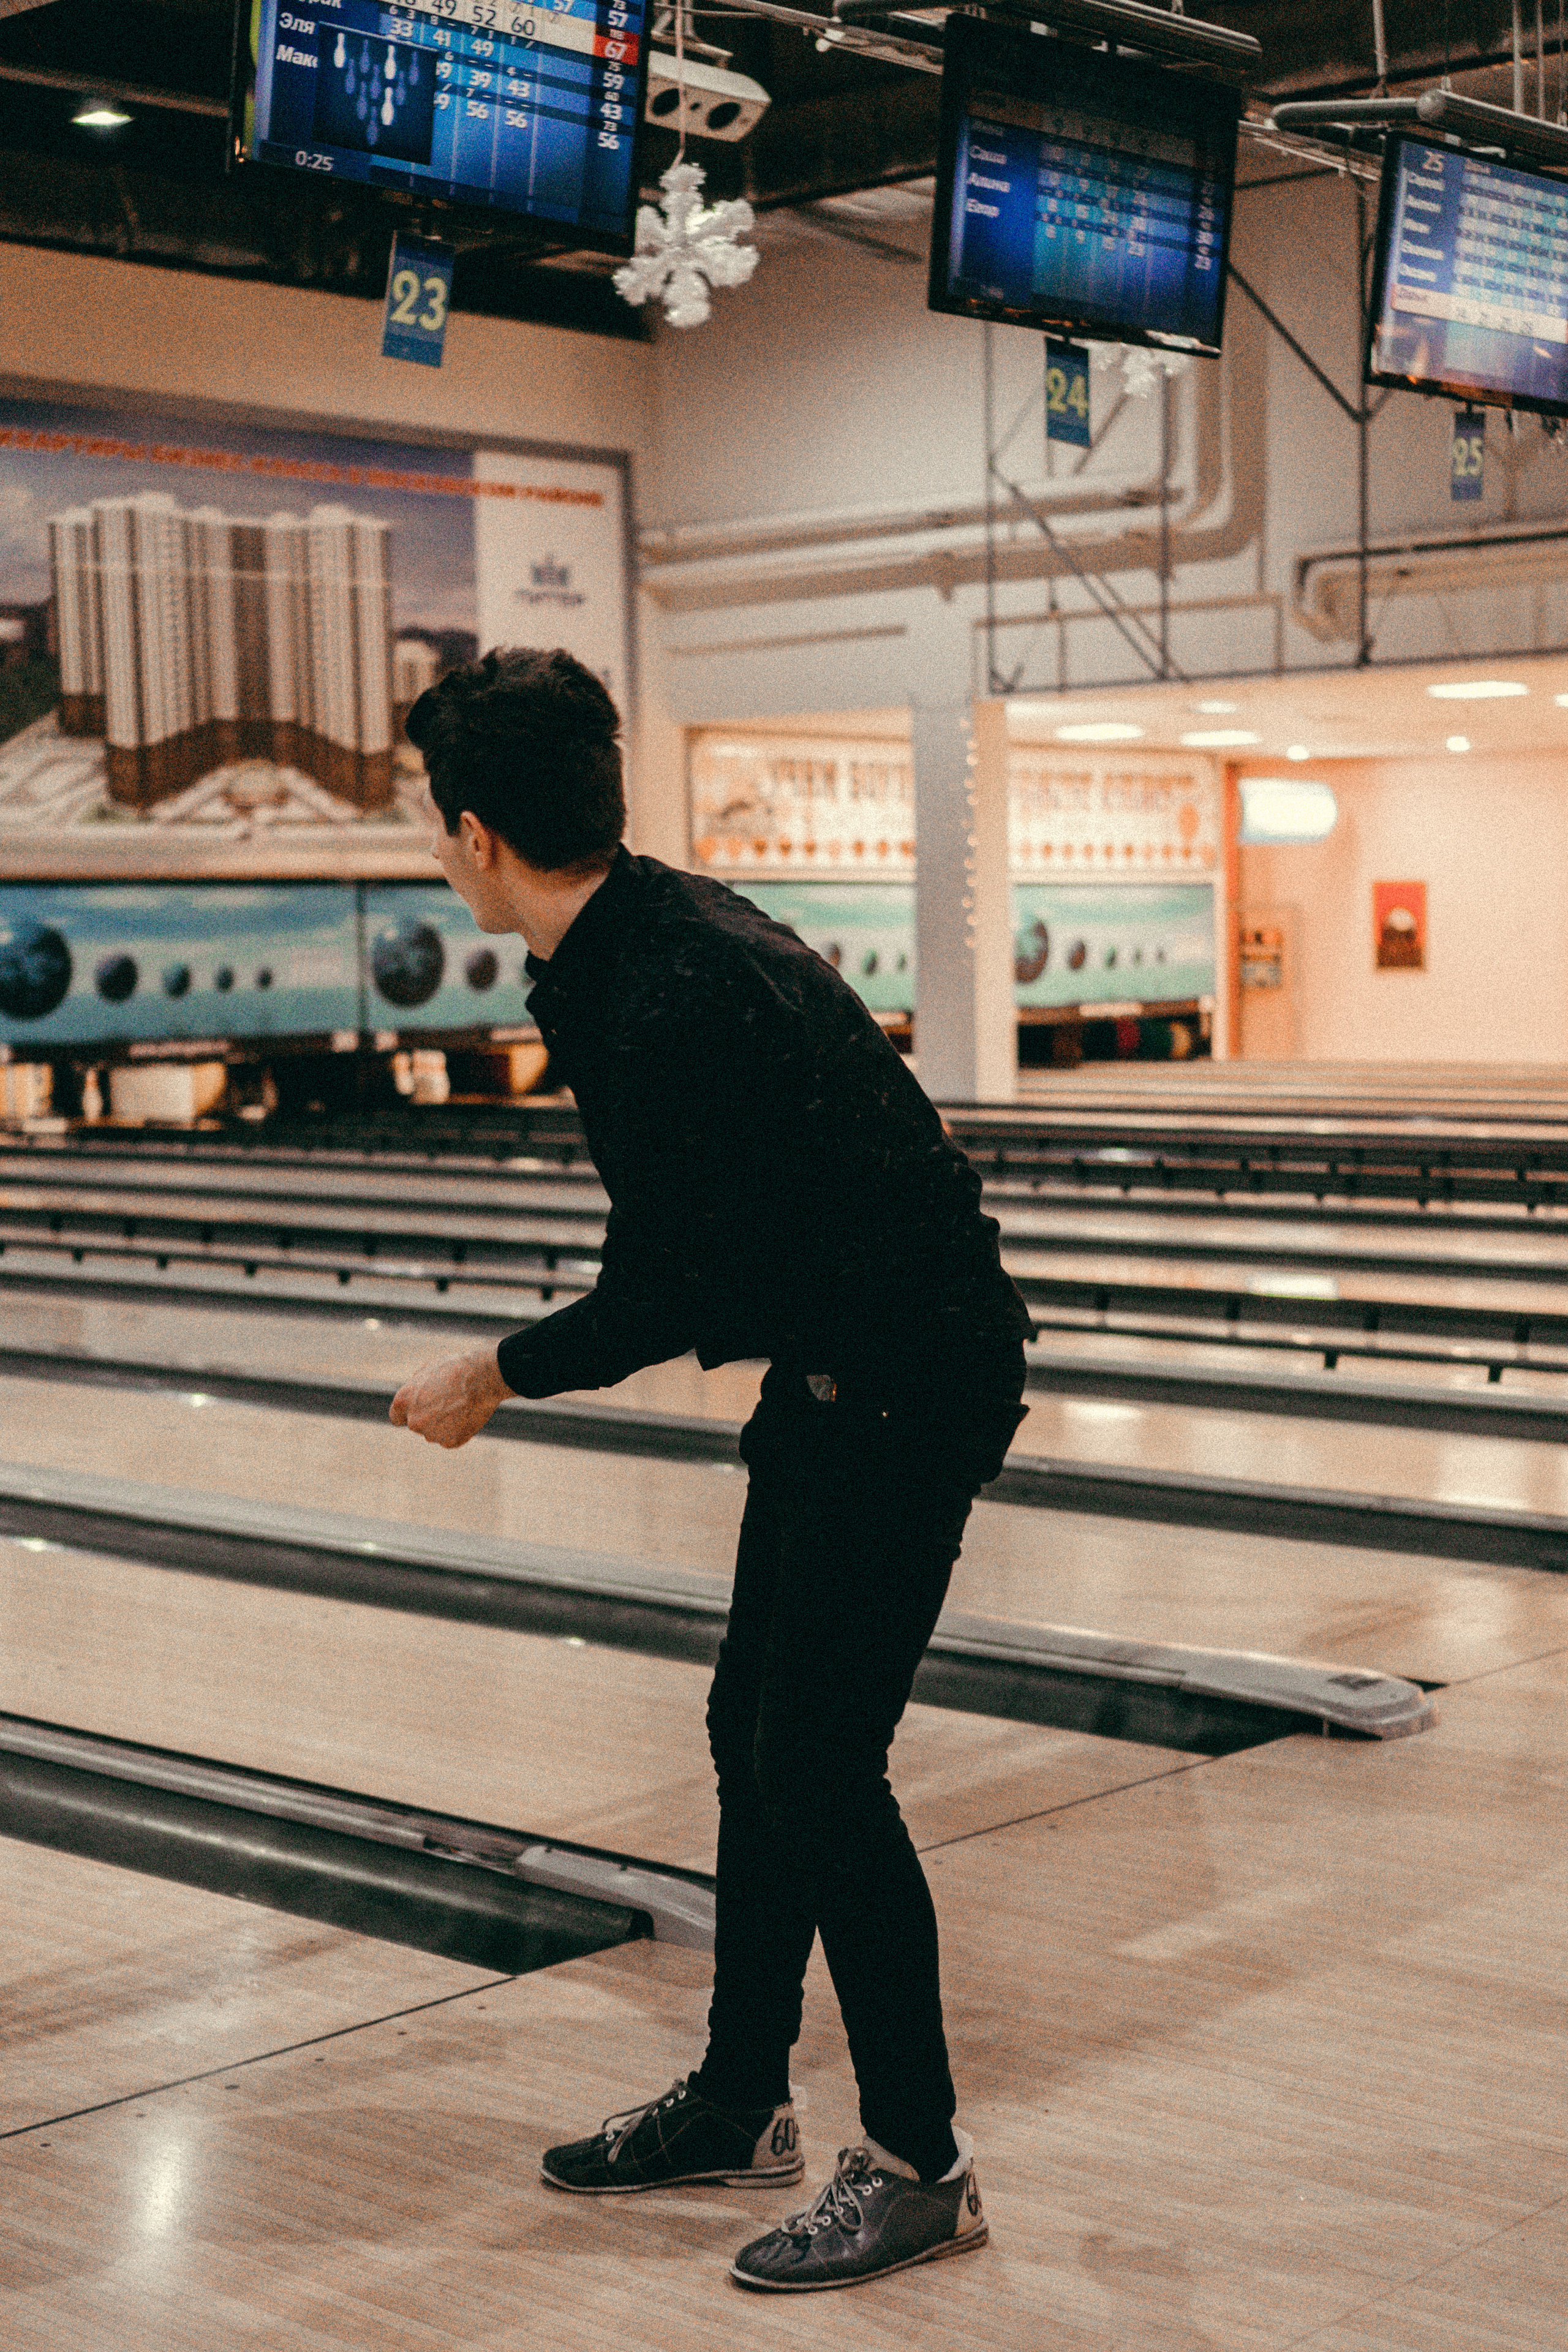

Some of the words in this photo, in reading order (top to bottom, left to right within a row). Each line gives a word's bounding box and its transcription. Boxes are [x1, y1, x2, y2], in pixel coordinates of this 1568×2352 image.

[279, 12, 315, 34] Эля
[472, 6, 497, 26] 52
[511, 17, 535, 36] 60
[608, 10, 628, 28] 57
[390, 18, 413, 37] 33
[432, 29, 451, 48] 41
[470, 39, 494, 58] 49
[605, 41, 627, 60] 67
[469, 69, 492, 89] 39
[507, 79, 530, 98] 43
[603, 72, 625, 89] 59
[466, 100, 489, 119] 56
[505, 110, 528, 129] 56
[600, 102, 622, 120] 43
[598, 132, 620, 150] 56
[295, 150, 334, 171] 0:25
[390, 270, 447, 331] 23
[1047, 368, 1088, 418] 24
[1453, 437, 1483, 476] 25
